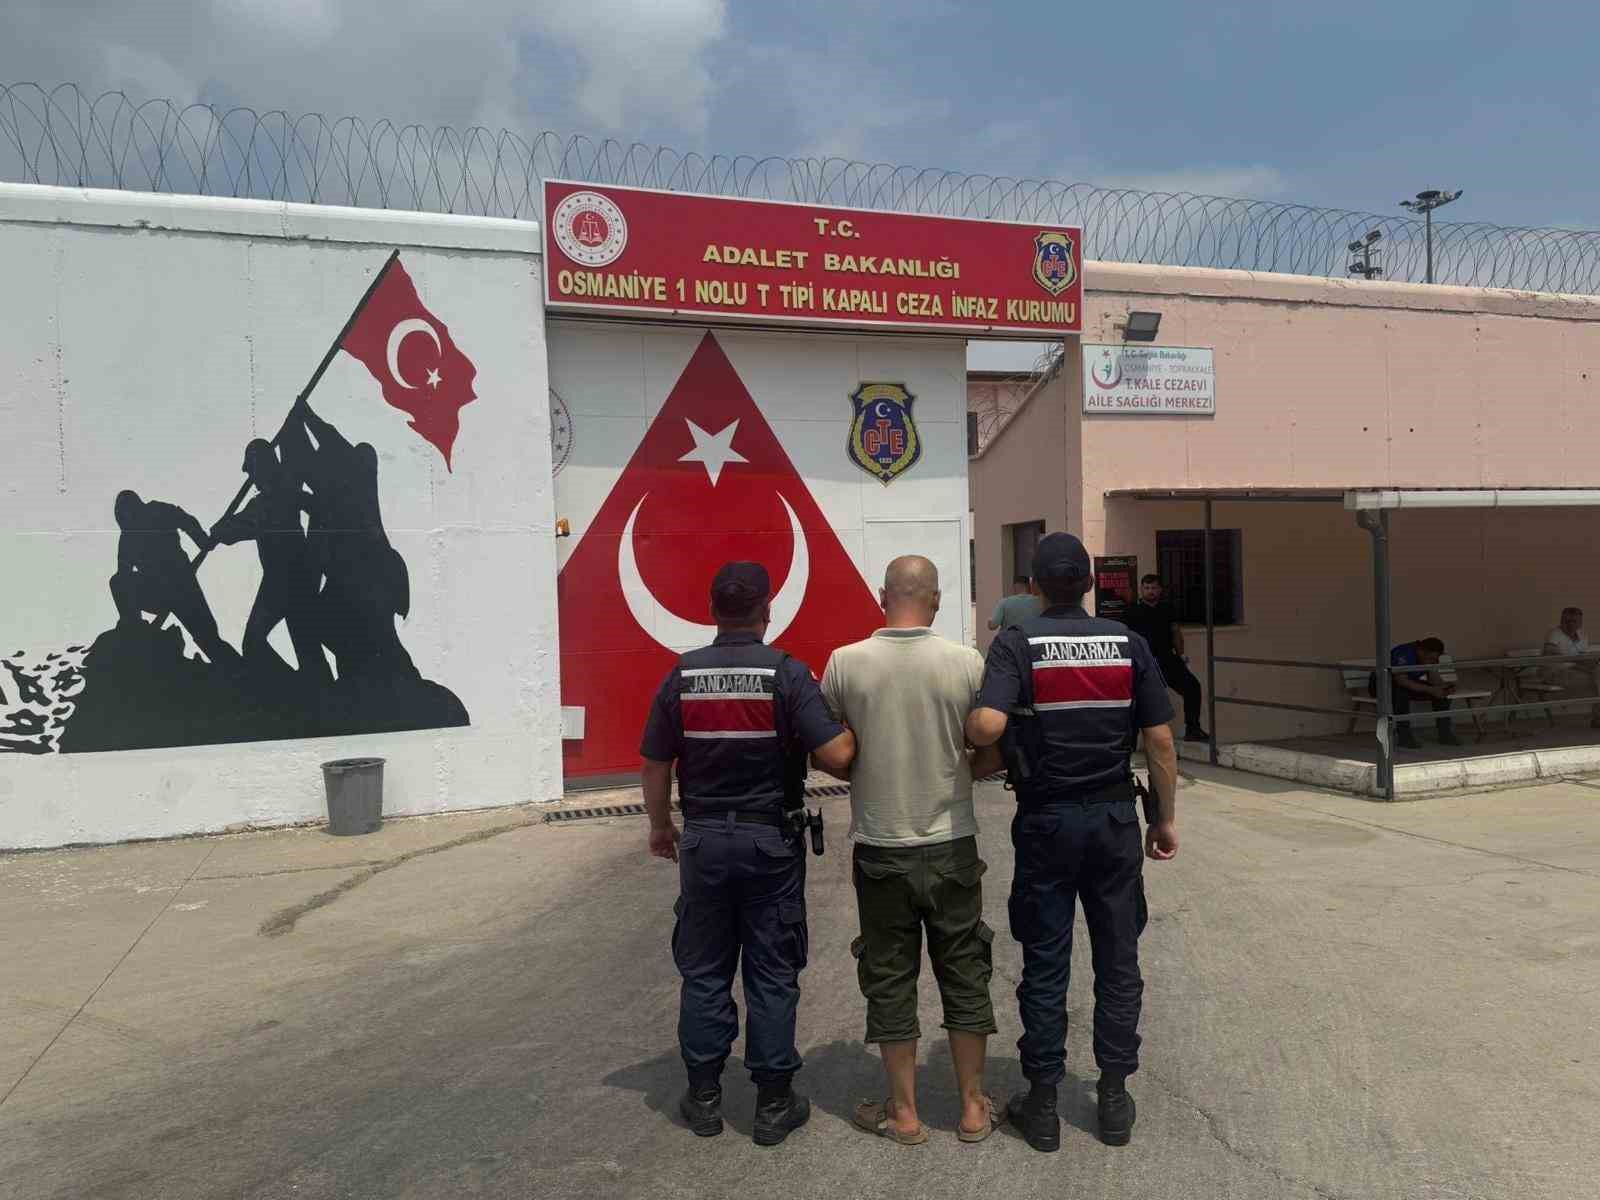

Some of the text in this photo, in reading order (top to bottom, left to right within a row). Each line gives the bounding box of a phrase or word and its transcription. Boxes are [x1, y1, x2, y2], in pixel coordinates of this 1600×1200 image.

[814, 218, 861, 239] T.C.
[703, 244, 960, 279] ADALET BAKANLIĞI
[557, 269, 1075, 324] OSMANİYE 1 NOLU T TİPİ KAPALI CEZA İNFAZ KURUMU
[1126, 378, 1161, 390] T.KALE
[1088, 394, 1212, 408] AİLE SAĞLIĞI MERKEZİ
[1041, 642, 1121, 660] JANDARMA
[689, 675, 764, 693] JANDARMA
